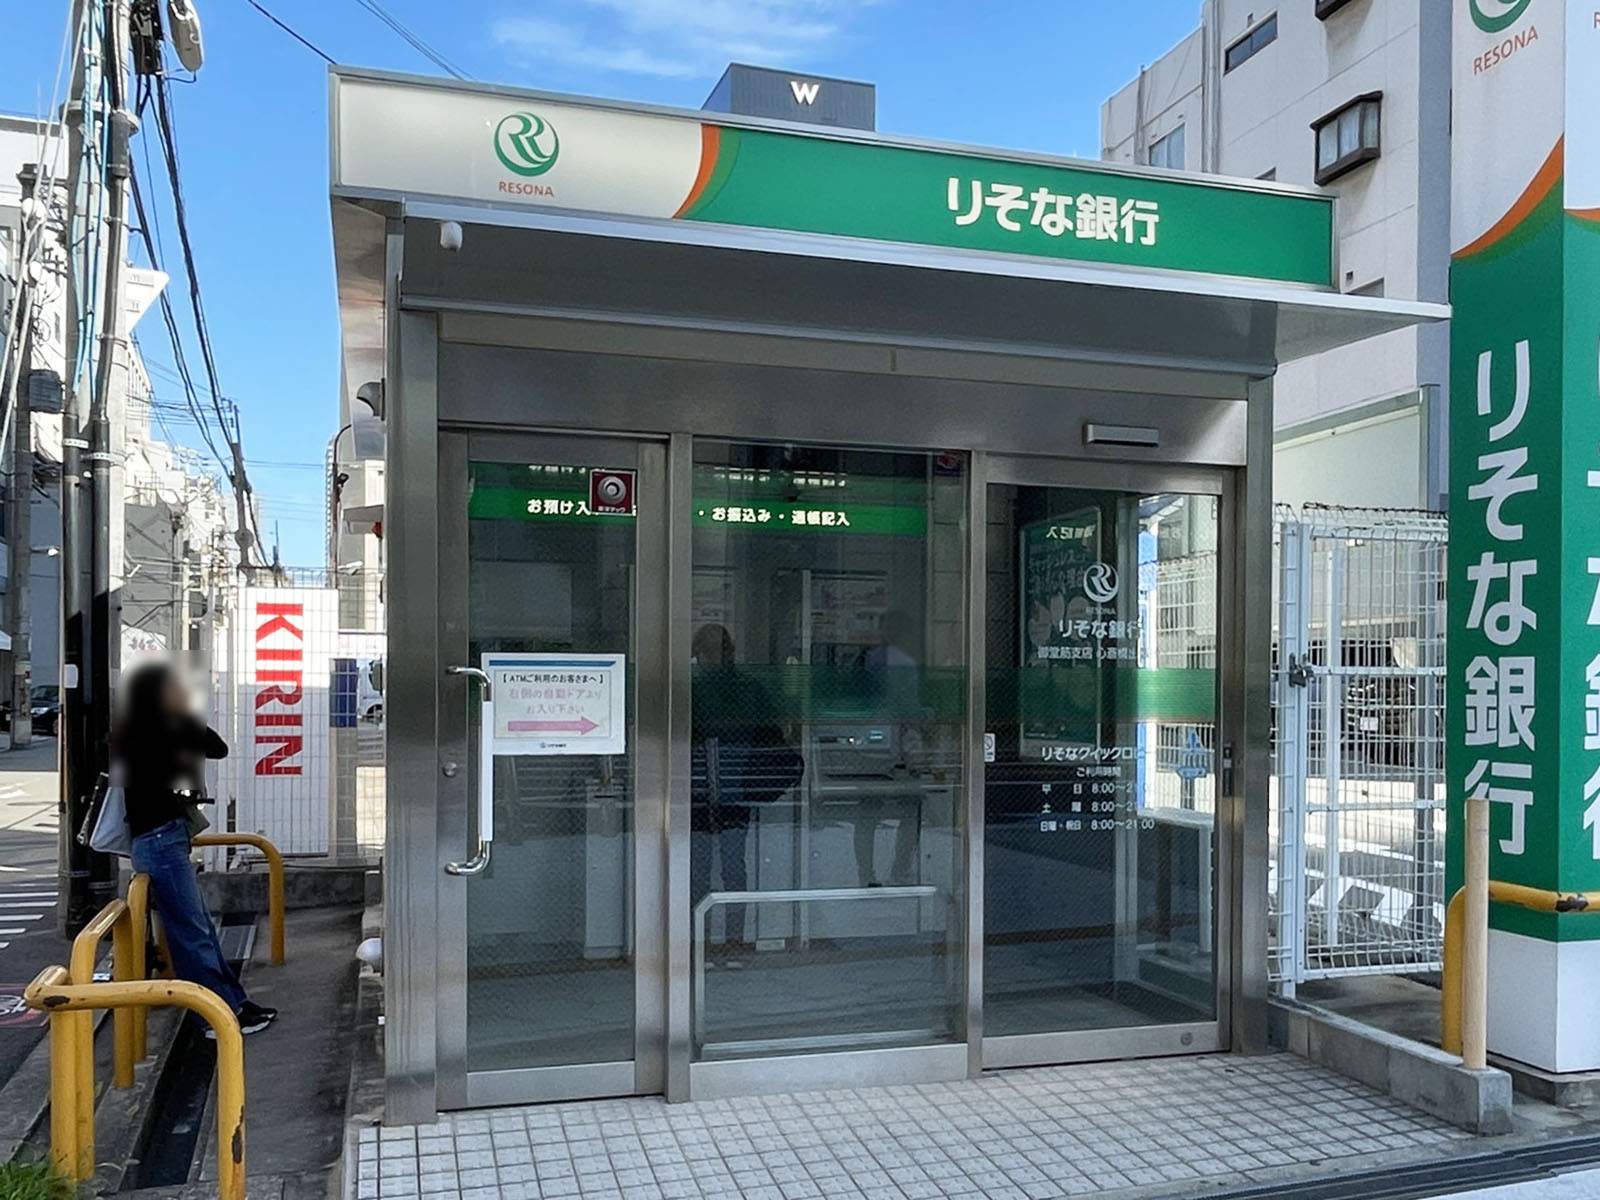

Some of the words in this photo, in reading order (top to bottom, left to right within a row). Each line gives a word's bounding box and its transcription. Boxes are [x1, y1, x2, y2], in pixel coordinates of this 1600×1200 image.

[1473, 25, 1539, 76] RESONA
[790, 81, 820, 105] W
[498, 181, 555, 197] RESONA
[947, 177, 1160, 246] りそな銀行
[527, 499, 600, 515] お預け入
[1464, 339, 1539, 855] りそな銀行
[1059, 618, 1142, 639] りそな銀行
[255, 603, 303, 775] KIRIN
[1041, 746, 1145, 761] りそなクイックロ
